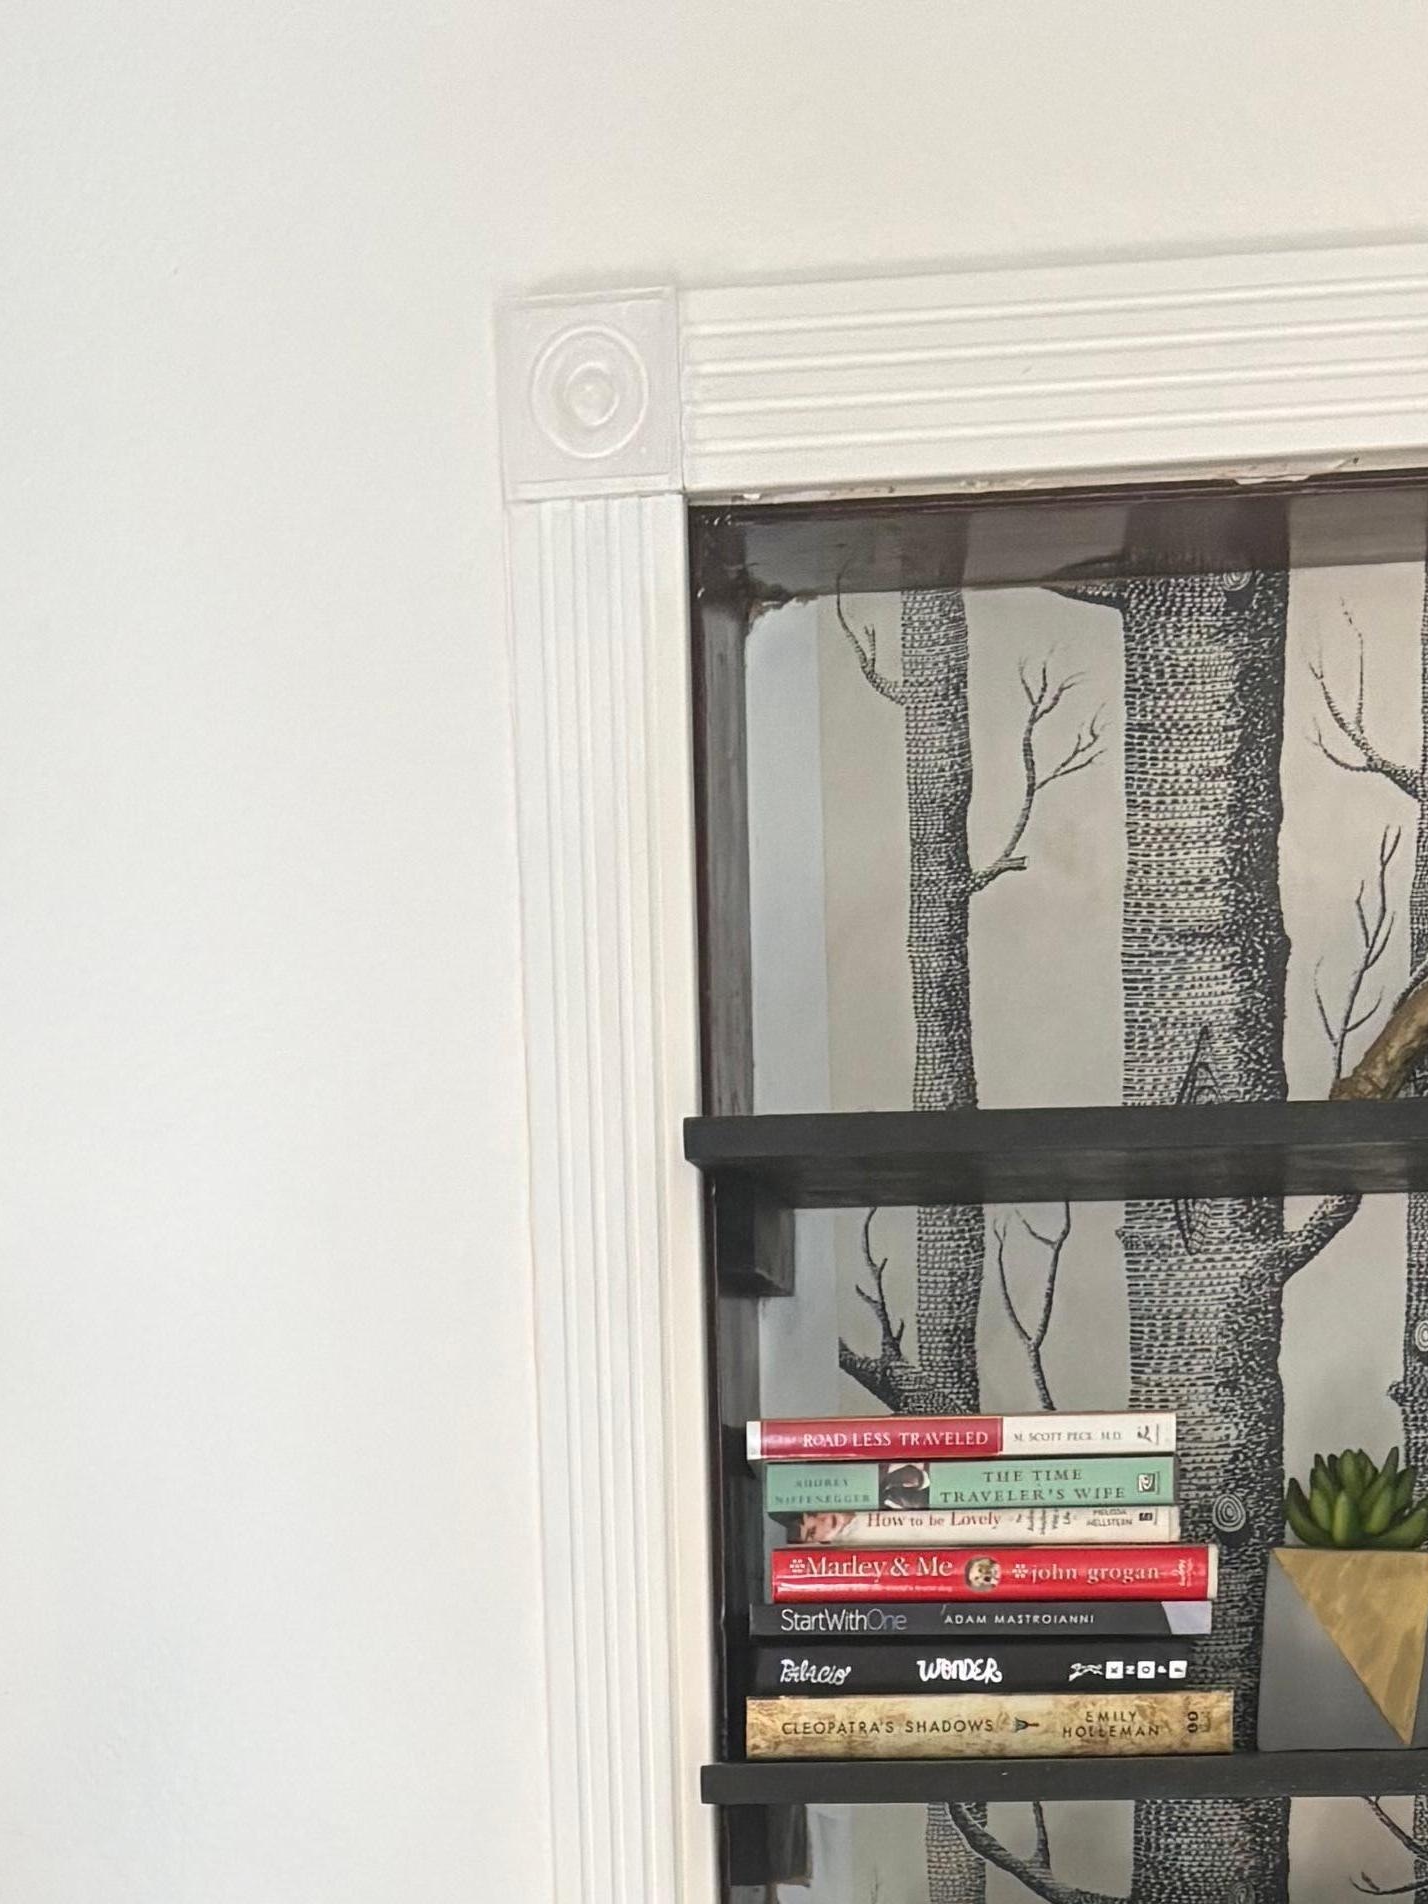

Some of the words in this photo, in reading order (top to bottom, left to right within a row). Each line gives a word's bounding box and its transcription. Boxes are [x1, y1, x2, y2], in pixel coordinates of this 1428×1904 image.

[803, 1432, 847, 1448] ROAD
[853, 1431, 891, 1447] LESS
[899, 1430, 989, 1447] TRAVELED
[983, 1470, 1024, 1483] THE
[1033, 1469, 1084, 1482] TIME
[940, 1486, 1066, 1504] TRAVELER'S
[1074, 1486, 1126, 1499] WIFE
[866, 1512, 907, 1528] How
[907, 1514, 924, 1527] to
[929, 1513, 946, 1527] be
[950, 1511, 1003, 1531] Lovely
[806, 1556, 888, 1583] Marley
[889, 1557, 910, 1577] &
[915, 1557, 954, 1577] Me
[1029, 1563, 1078, 1584] john
[1086, 1567, 1161, 1585] grogan
[780, 1607, 909, 1632] StartWithOne
[944, 1614, 988, 1625] ADAM
[994, 1613, 1095, 1625] MASTROIANNI
[916, 1657, 1004, 1684] WONDER
[1085, 1710, 1137, 1723] EMILY
[781, 1720, 895, 1736] CLEOPATRA'S
[904, 1718, 994, 1734] SHADOWS
[1062, 1725, 1160, 1738] HOLLEMAN
